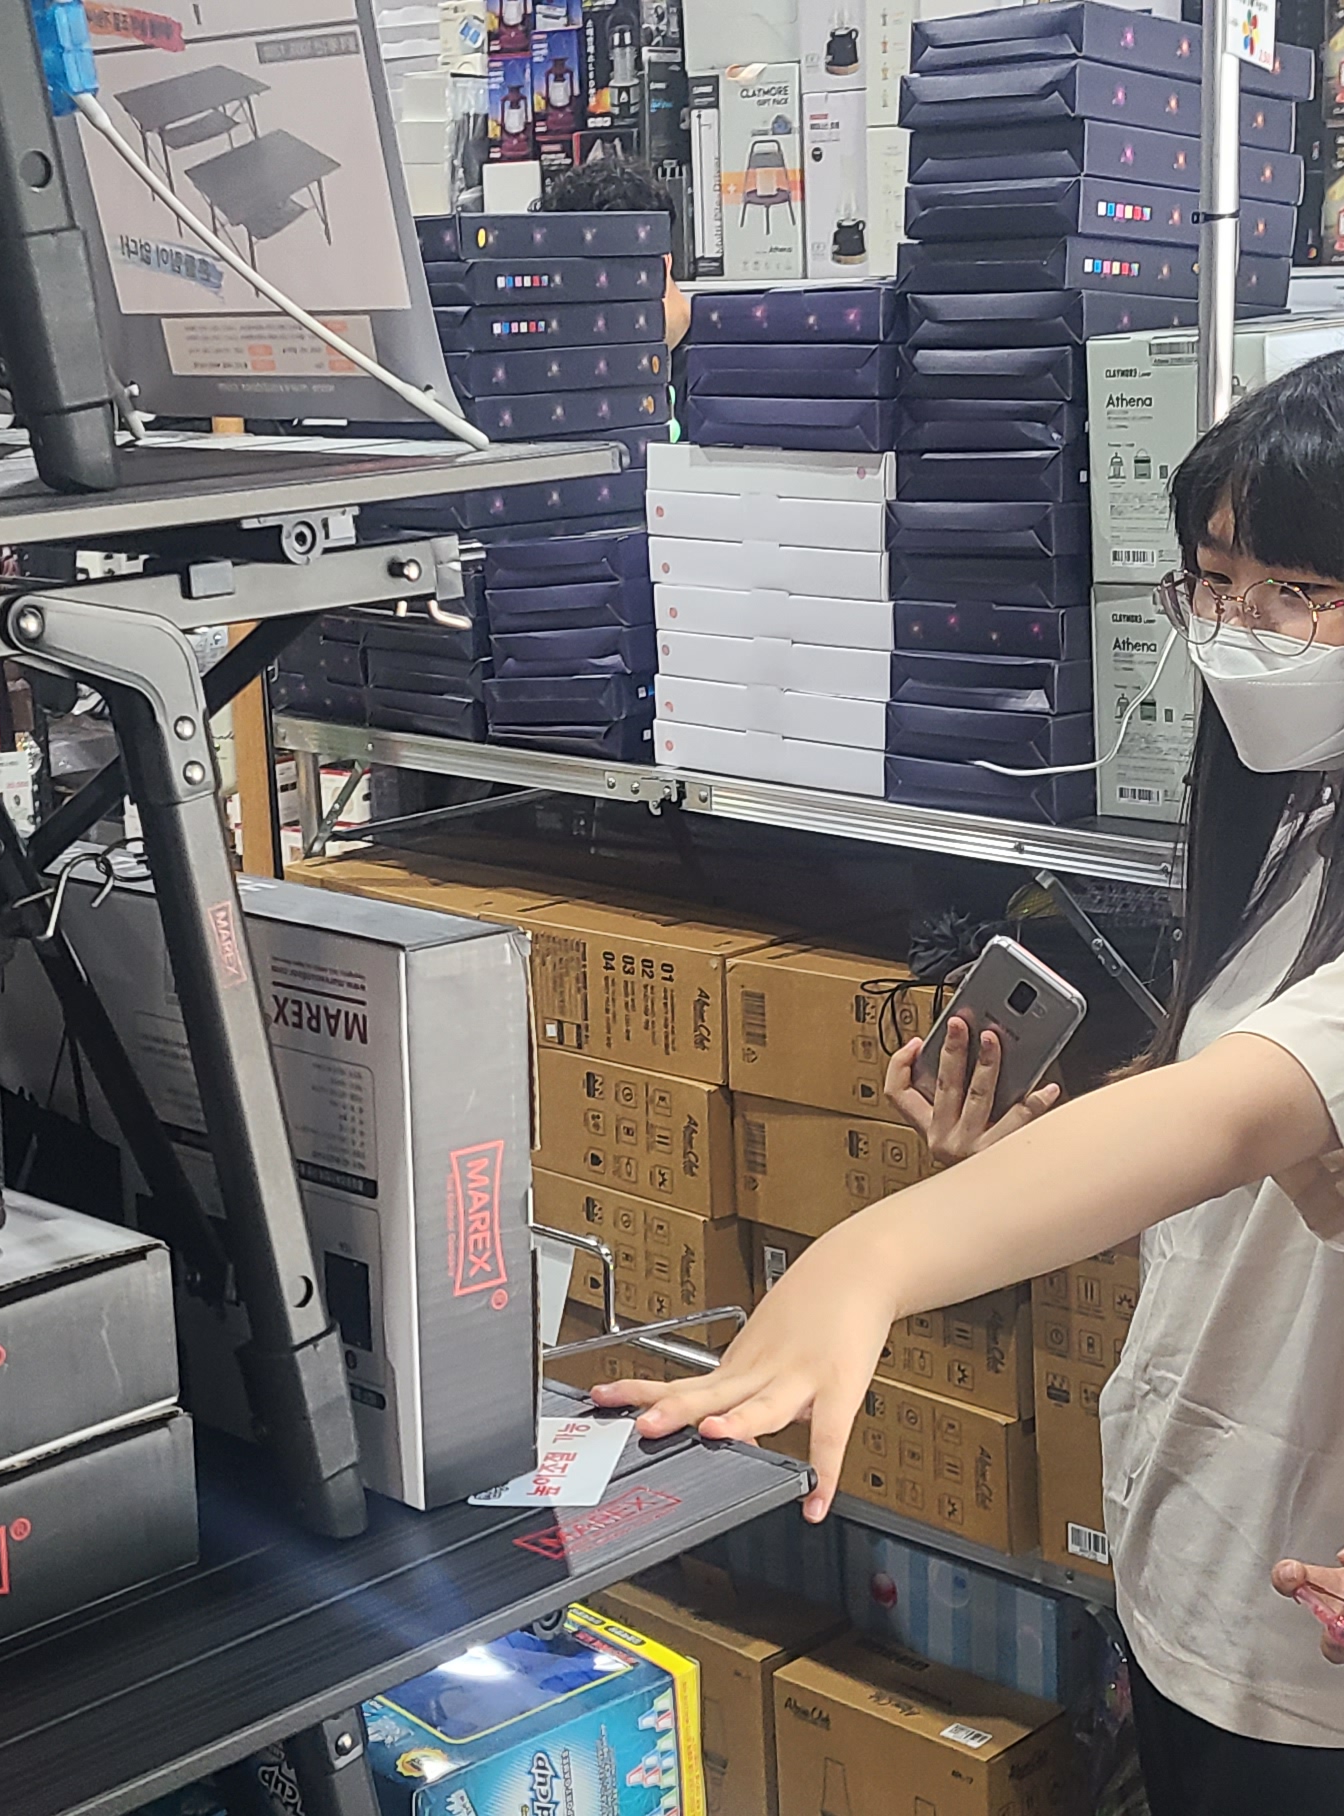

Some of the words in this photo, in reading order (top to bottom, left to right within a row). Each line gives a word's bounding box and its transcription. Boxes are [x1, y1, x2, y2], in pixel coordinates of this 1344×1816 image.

[1106, 393, 1153, 408] Athena
[1112, 637, 1158, 652] Athena
[602, 950, 616, 972] 04
[622, 954, 635, 976] 03
[640, 958, 654, 980] 02
[660, 962, 675, 983] 01
[271, 993, 369, 1046] MAREX
[466, 1157, 493, 1278] MAREX
